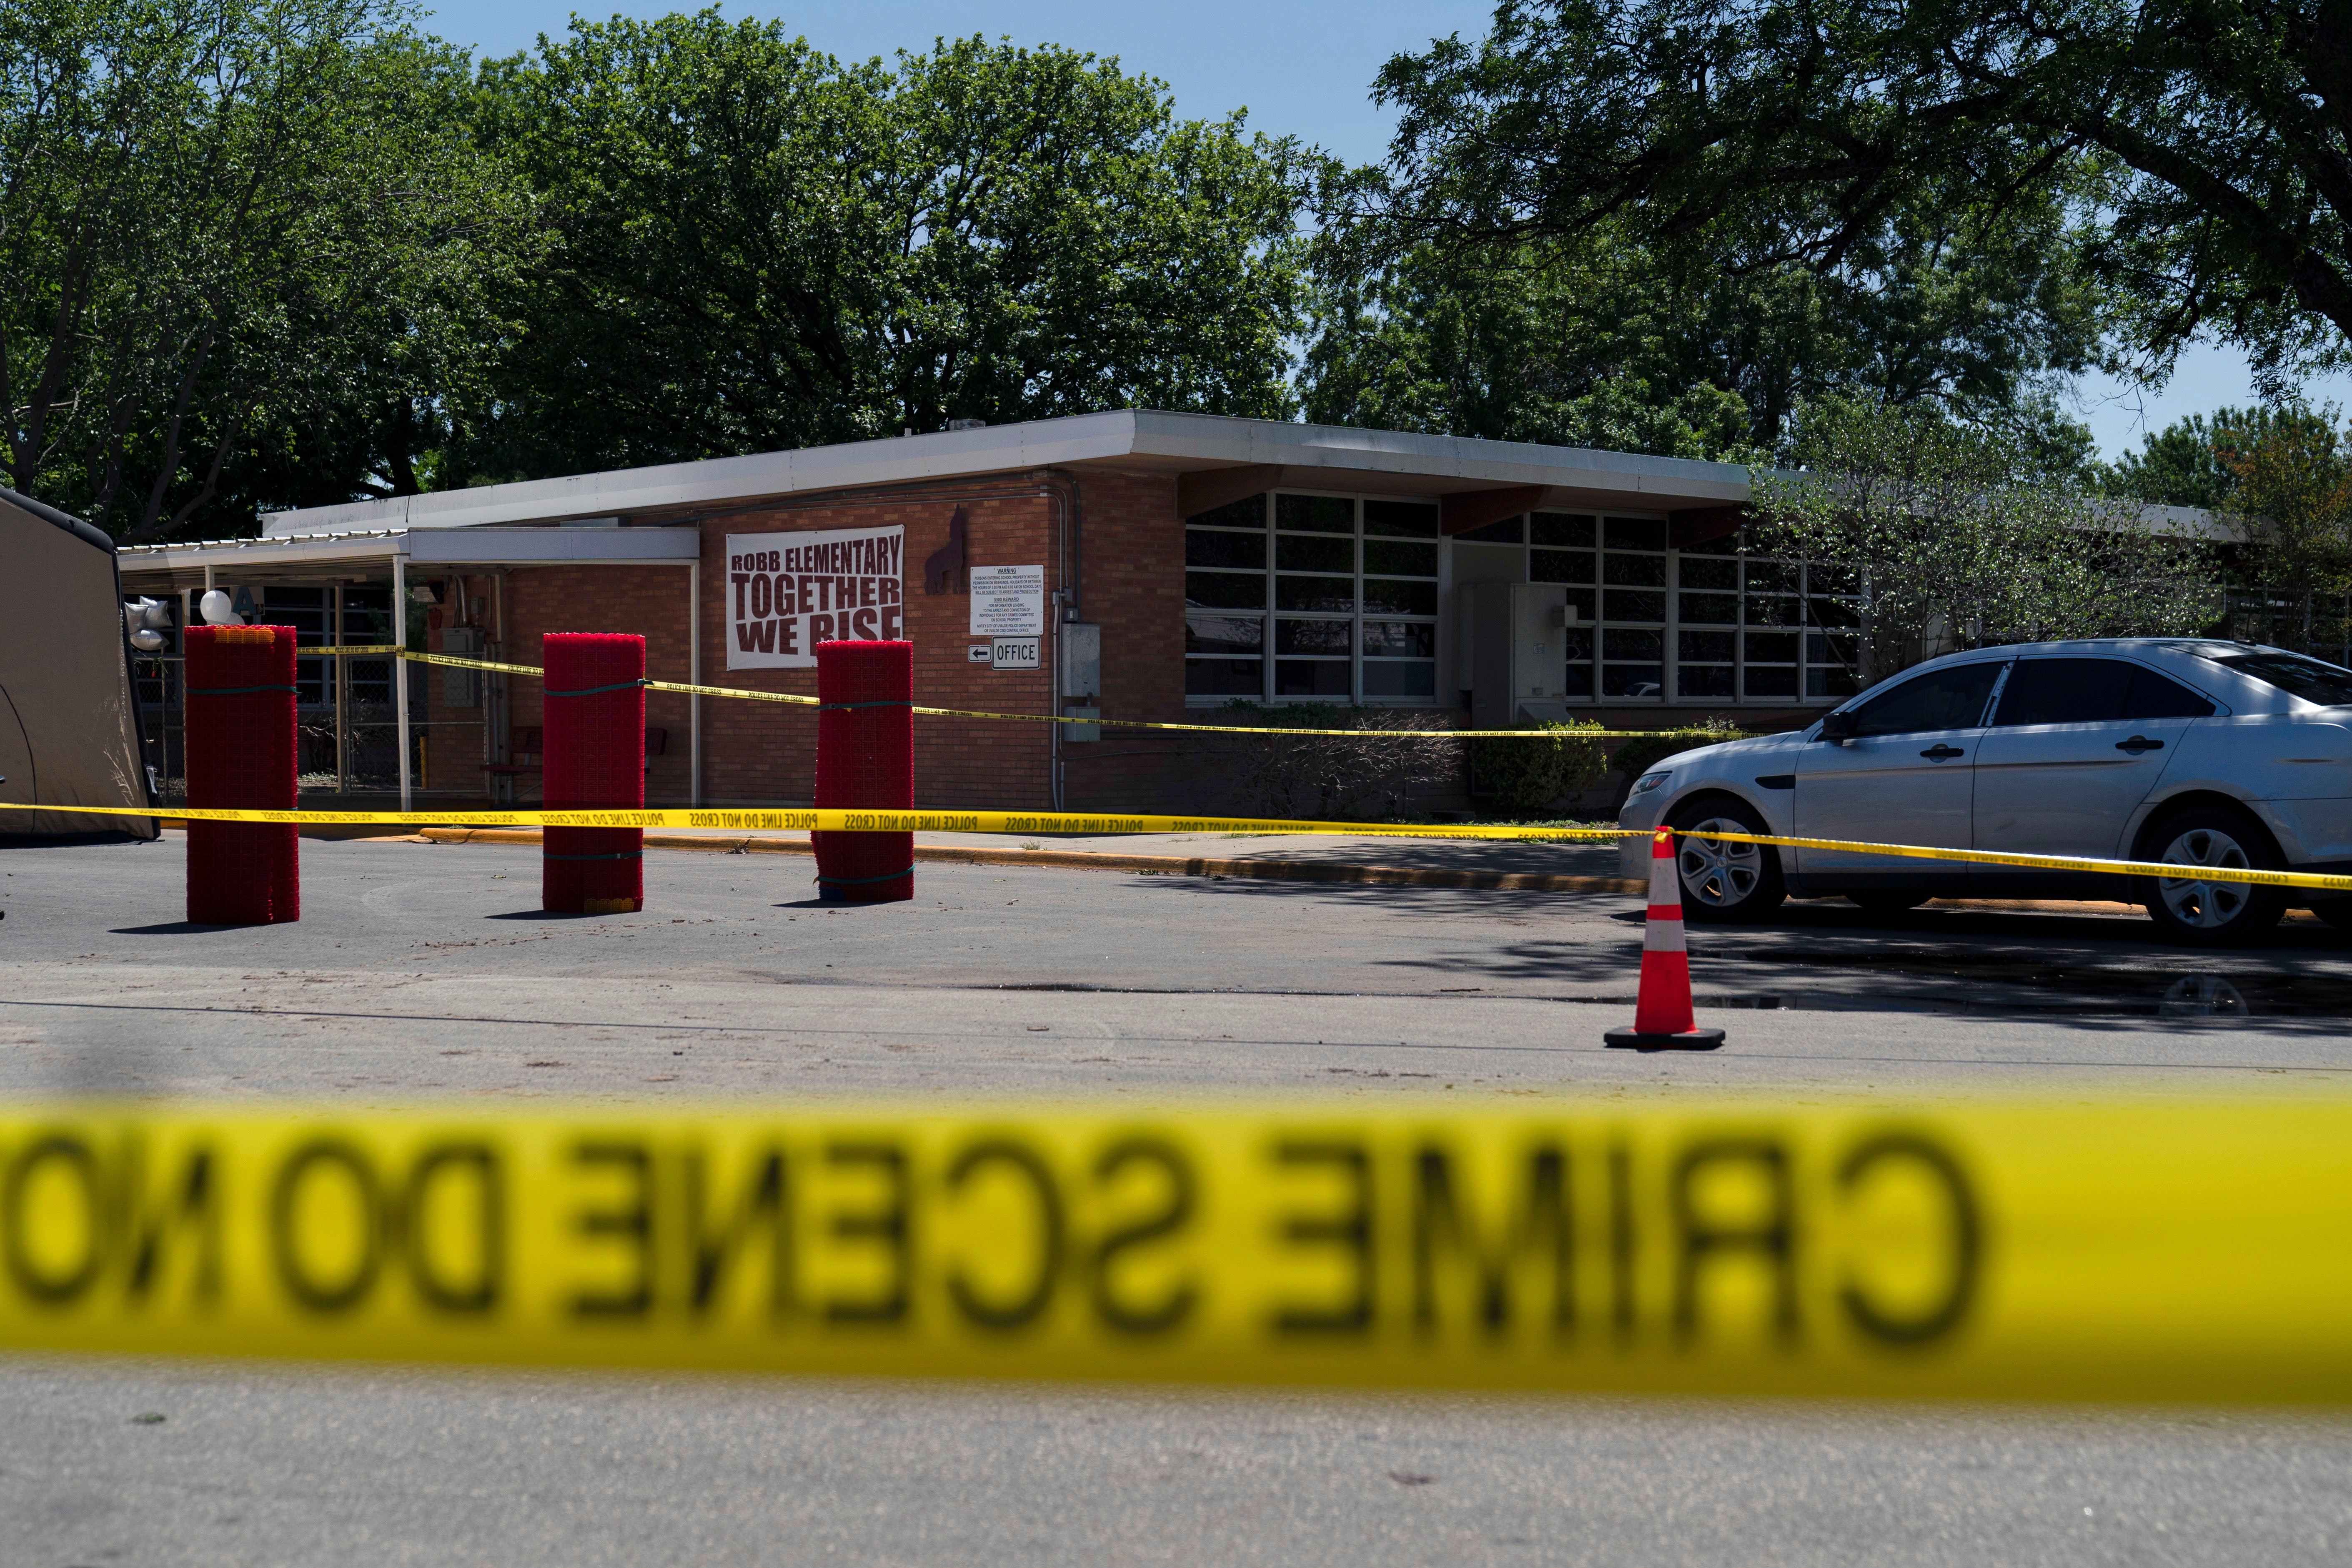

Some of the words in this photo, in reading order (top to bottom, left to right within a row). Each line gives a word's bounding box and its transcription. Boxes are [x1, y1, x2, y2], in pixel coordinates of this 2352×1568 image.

[731, 550, 781, 572] ROBB
[785, 534, 902, 576] ELEMENTARY
[233, 586, 257, 615] A
[731, 573, 901, 620] TOGETHER
[736, 617, 798, 655] WE
[810, 605, 901, 656] RISE
[997, 644, 1035, 660] OFFICE
